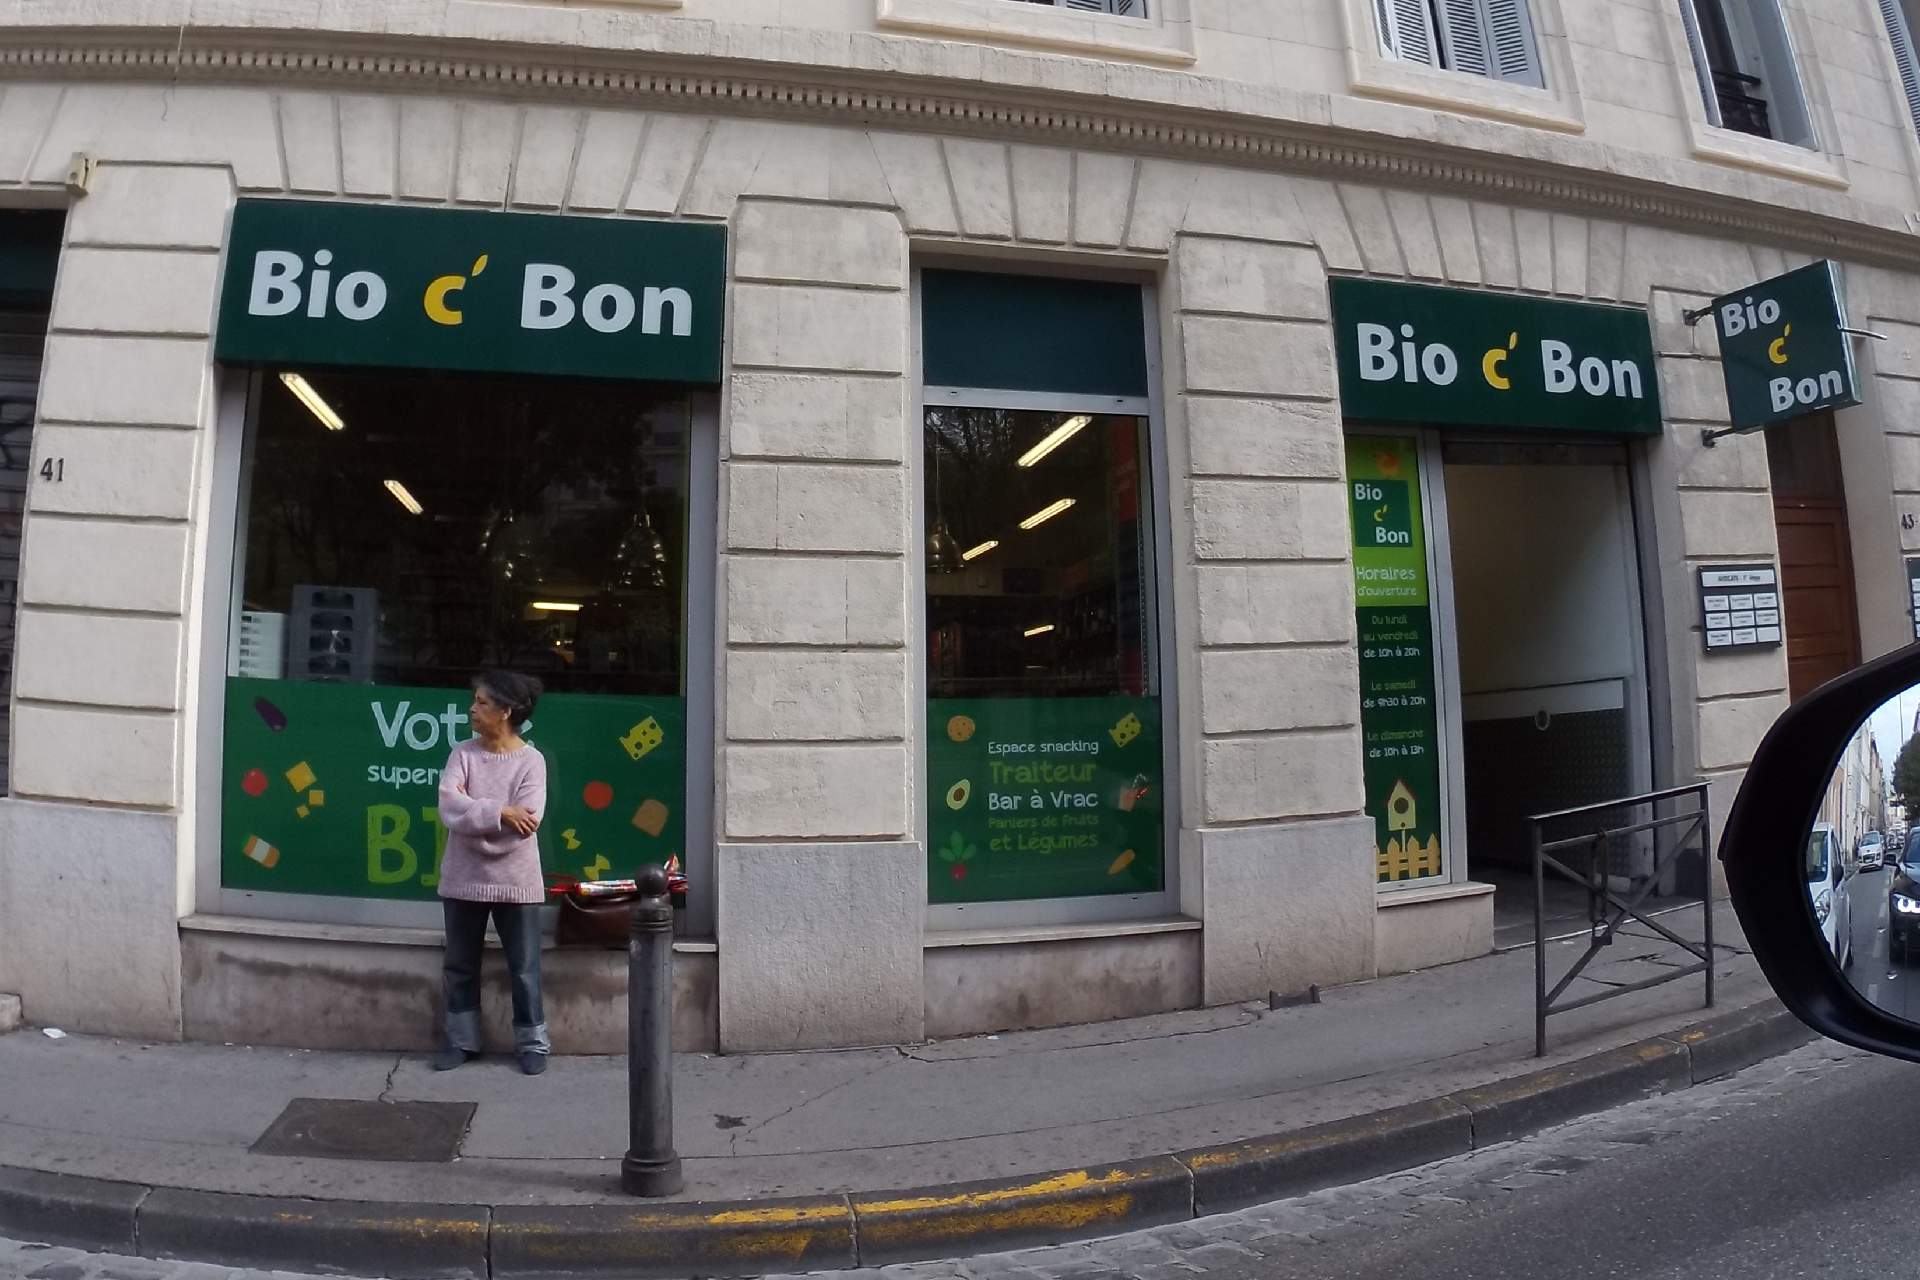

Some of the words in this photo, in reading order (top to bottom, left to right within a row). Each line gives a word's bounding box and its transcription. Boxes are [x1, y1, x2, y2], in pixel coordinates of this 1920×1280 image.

[248, 248, 388, 321] Bio
[520, 262, 693, 337] Bon
[1720, 296, 1780, 337] Bio
[1357, 322, 1458, 386] Bio
[1541, 339, 1643, 399] Bon
[1769, 370, 1843, 413] Bon
[40, 457, 65, 482] 41
[1354, 483, 1383, 501] Bio
[1375, 526, 1409, 544] Bon
[1356, 566, 1416, 581] Horaires
[1385, 614, 1408, 625] lundi
[1377, 631, 1419, 642] vendredi
[1363, 648, 1378, 658] de
[1378, 648, 1394, 658] 10h
[1396, 645, 1403, 657] à
[1404, 647, 1421, 657] 20h
[1371, 681, 1382, 691] Le
[1383, 680, 1416, 691] samedi
[1362, 698, 1376, 709] de
[1377, 697, 1400, 708] 9h30
[1401, 695, 1408, 706] à
[1410, 696, 1427, 706] 20h
[1380, 729, 1425, 741] dimanche
[987, 741, 1036, 756] Espace
[1039, 740, 1099, 756] snacking
[1369, 748, 1382, 758] de
[1384, 747, 1400, 757] 10h
[1401, 745, 1408, 756] à
[988, 760, 1098, 785] Traiteur
[988, 791, 1023, 811] Bar
[1030, 789, 1044, 809] à
[1050, 790, 1099, 809] Vrac
[988, 816, 1037, 829] Paniers
[1041, 815, 1057, 827] de
[989, 834, 1012, 852] et
[1018, 831, 1099, 855] Légumes
